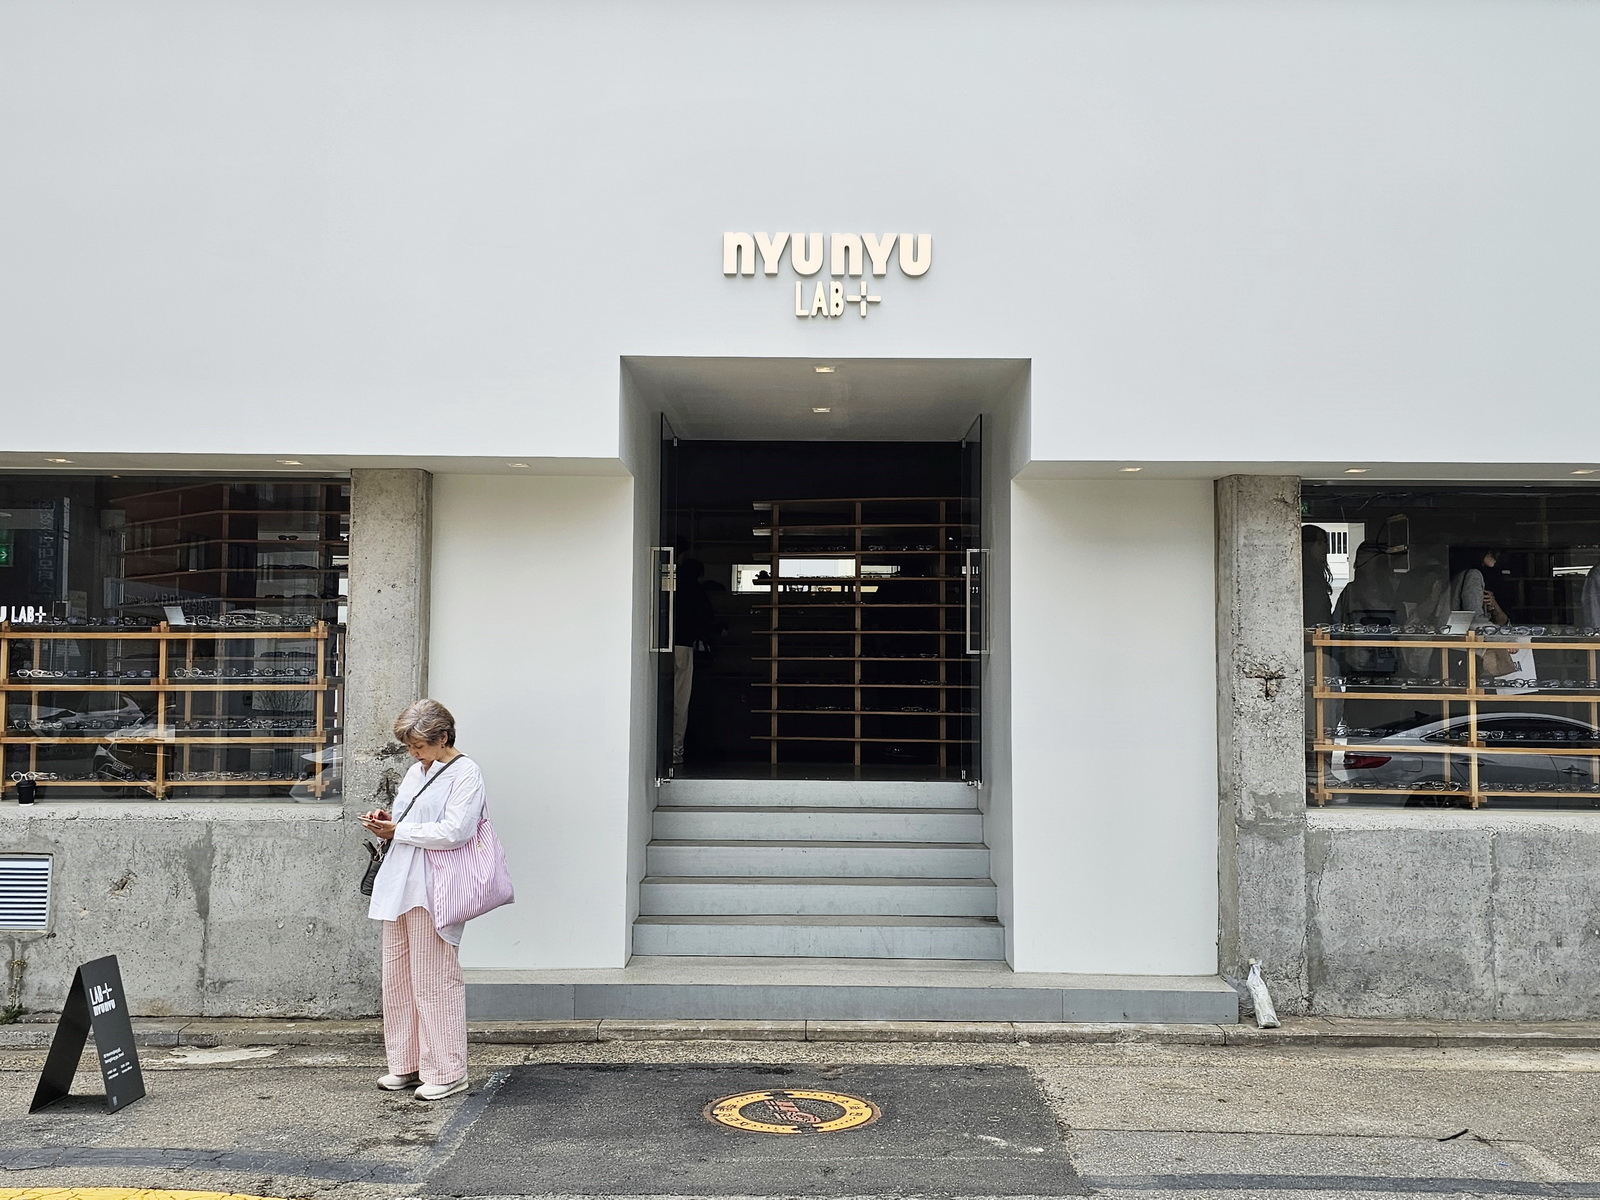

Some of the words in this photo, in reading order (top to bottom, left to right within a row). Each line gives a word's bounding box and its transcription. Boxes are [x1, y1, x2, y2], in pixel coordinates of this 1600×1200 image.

[795, 281, 882, 317] LAB+
[11, 606, 47, 623] LAB+
[89, 982, 113, 1006] LAB+
